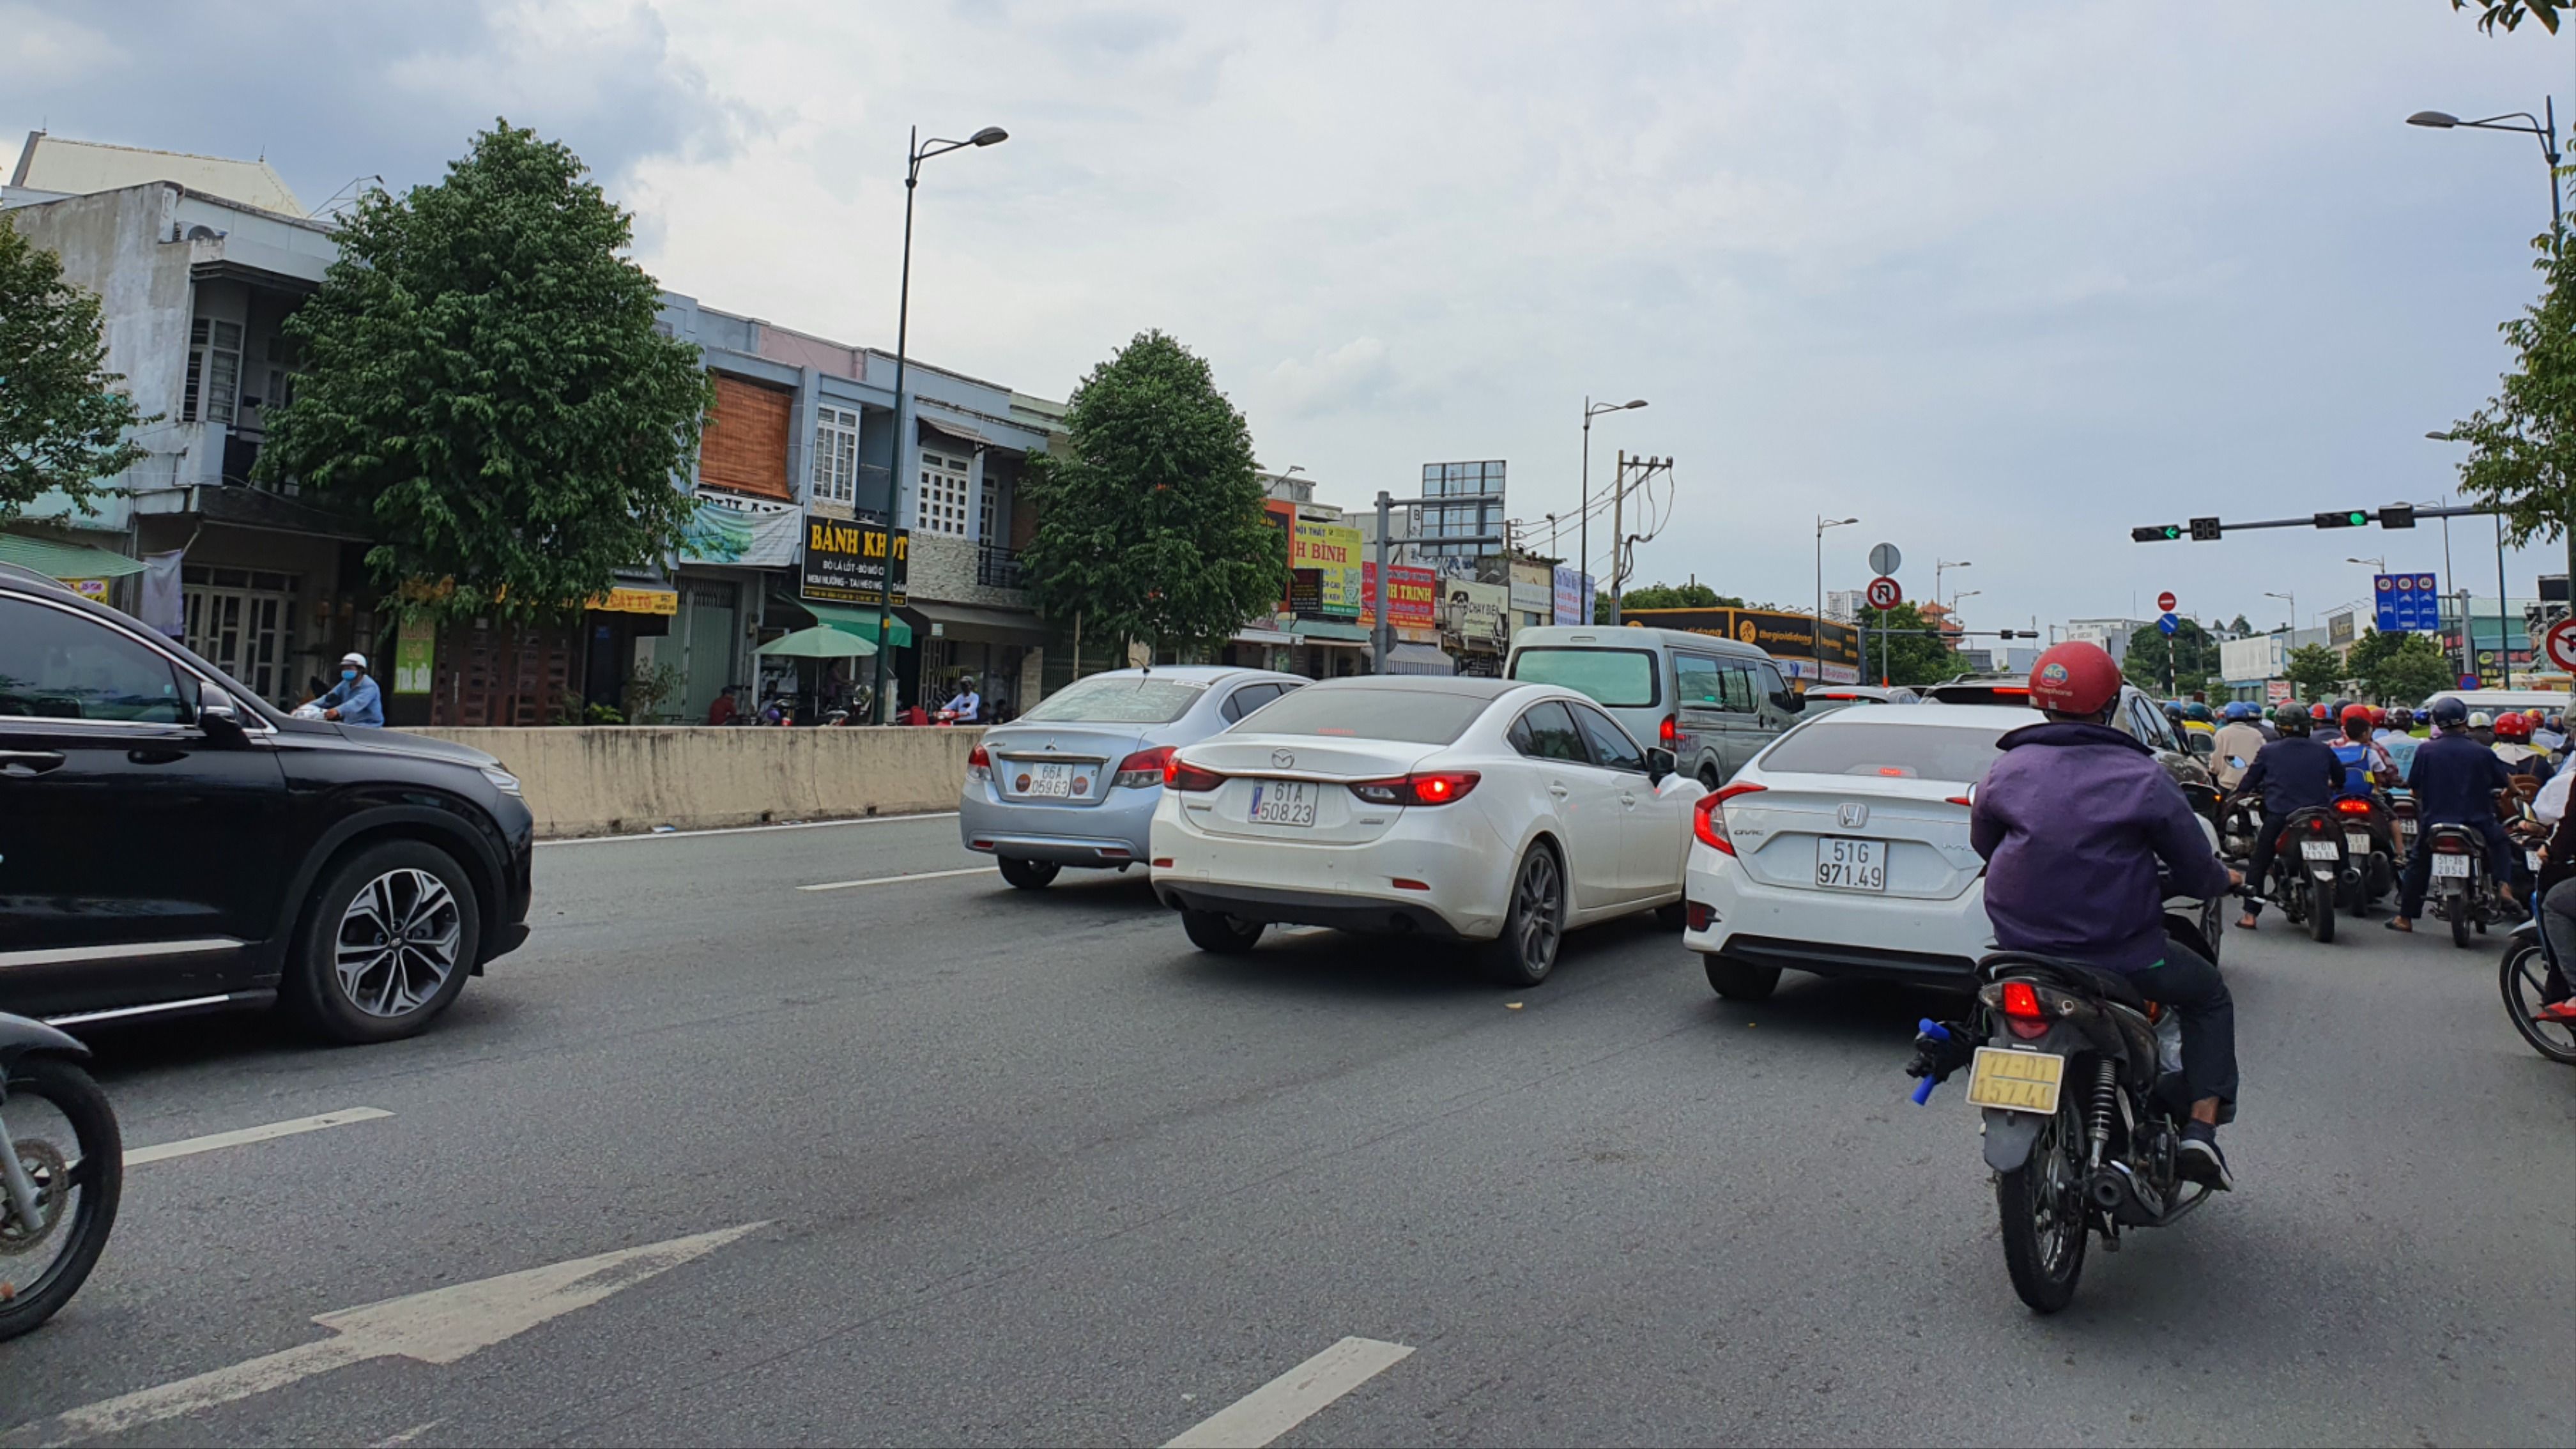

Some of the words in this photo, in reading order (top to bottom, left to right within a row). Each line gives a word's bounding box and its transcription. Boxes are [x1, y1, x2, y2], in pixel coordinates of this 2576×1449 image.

[811, 519, 859, 555] BÁNH
[1312, 540, 1347, 563] BÌNH
[1042, 765, 1062, 779] 66A
[1032, 780, 1068, 794] 059.63
[1275, 783, 1303, 802] 61A
[1261, 802, 1312, 824] 508.23
[1834, 841, 1869, 864] 51G
[1818, 863, 1882, 888] 971.49
